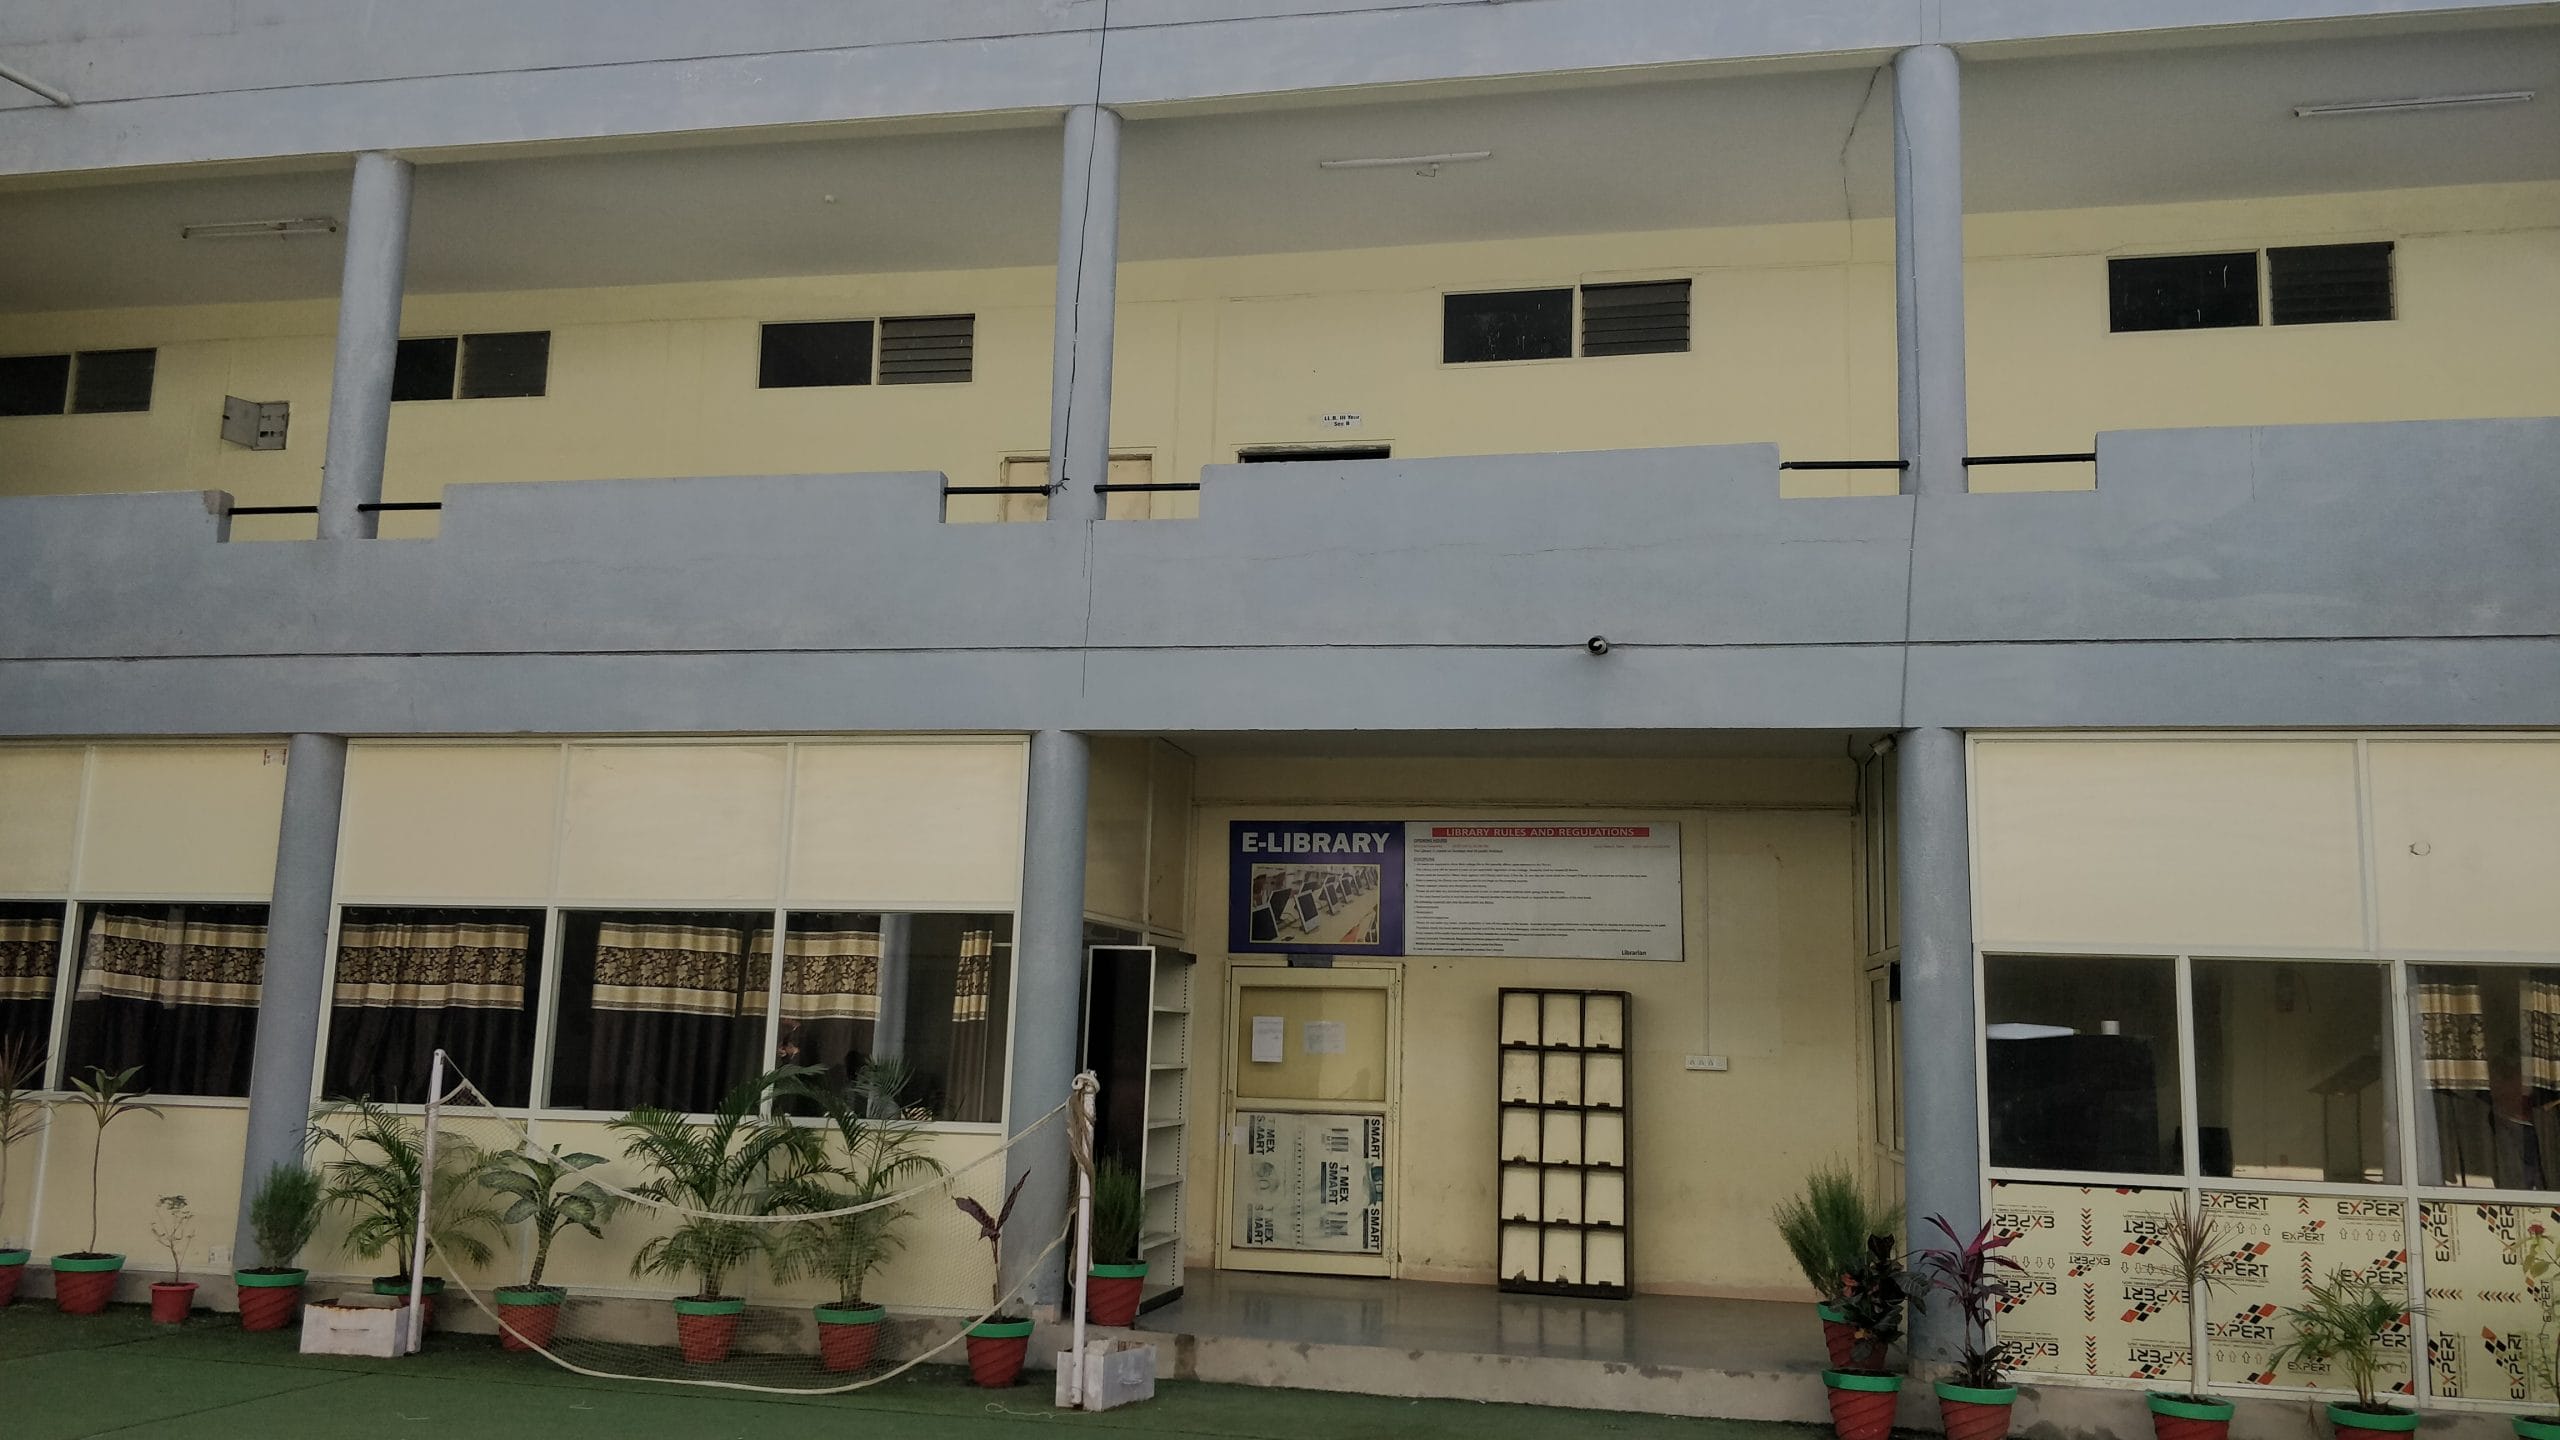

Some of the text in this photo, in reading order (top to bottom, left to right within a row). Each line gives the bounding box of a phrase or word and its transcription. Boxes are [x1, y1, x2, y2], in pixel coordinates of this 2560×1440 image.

[1242, 831, 1391, 853] E-LIBRARY
[1446, 828, 1635, 837] LIBRARY RULES AND REGULATIONS
[1371, 1118, 1380, 1160] SMART
[1329, 1161, 1338, 1205] SMART
[2201, 1192, 2269, 1211] EXPERT
[2337, 1200, 2404, 1217] EXPER
[1370, 1208, 1380, 1250] SMART
[1993, 1213, 2055, 1232] EXPER
[2281, 1231, 2325, 1242] EXPERT
[2068, 1255, 2111, 1266] EXPERT
[2341, 1268, 2408, 1286] EXPER
[2123, 1286, 2190, 1305] EXPERT
[2207, 1321, 2275, 1340] EXPERT
[2440, 1331, 2457, 1398] EXPERT
[2508, 1333, 2525, 1400] EXPERT
